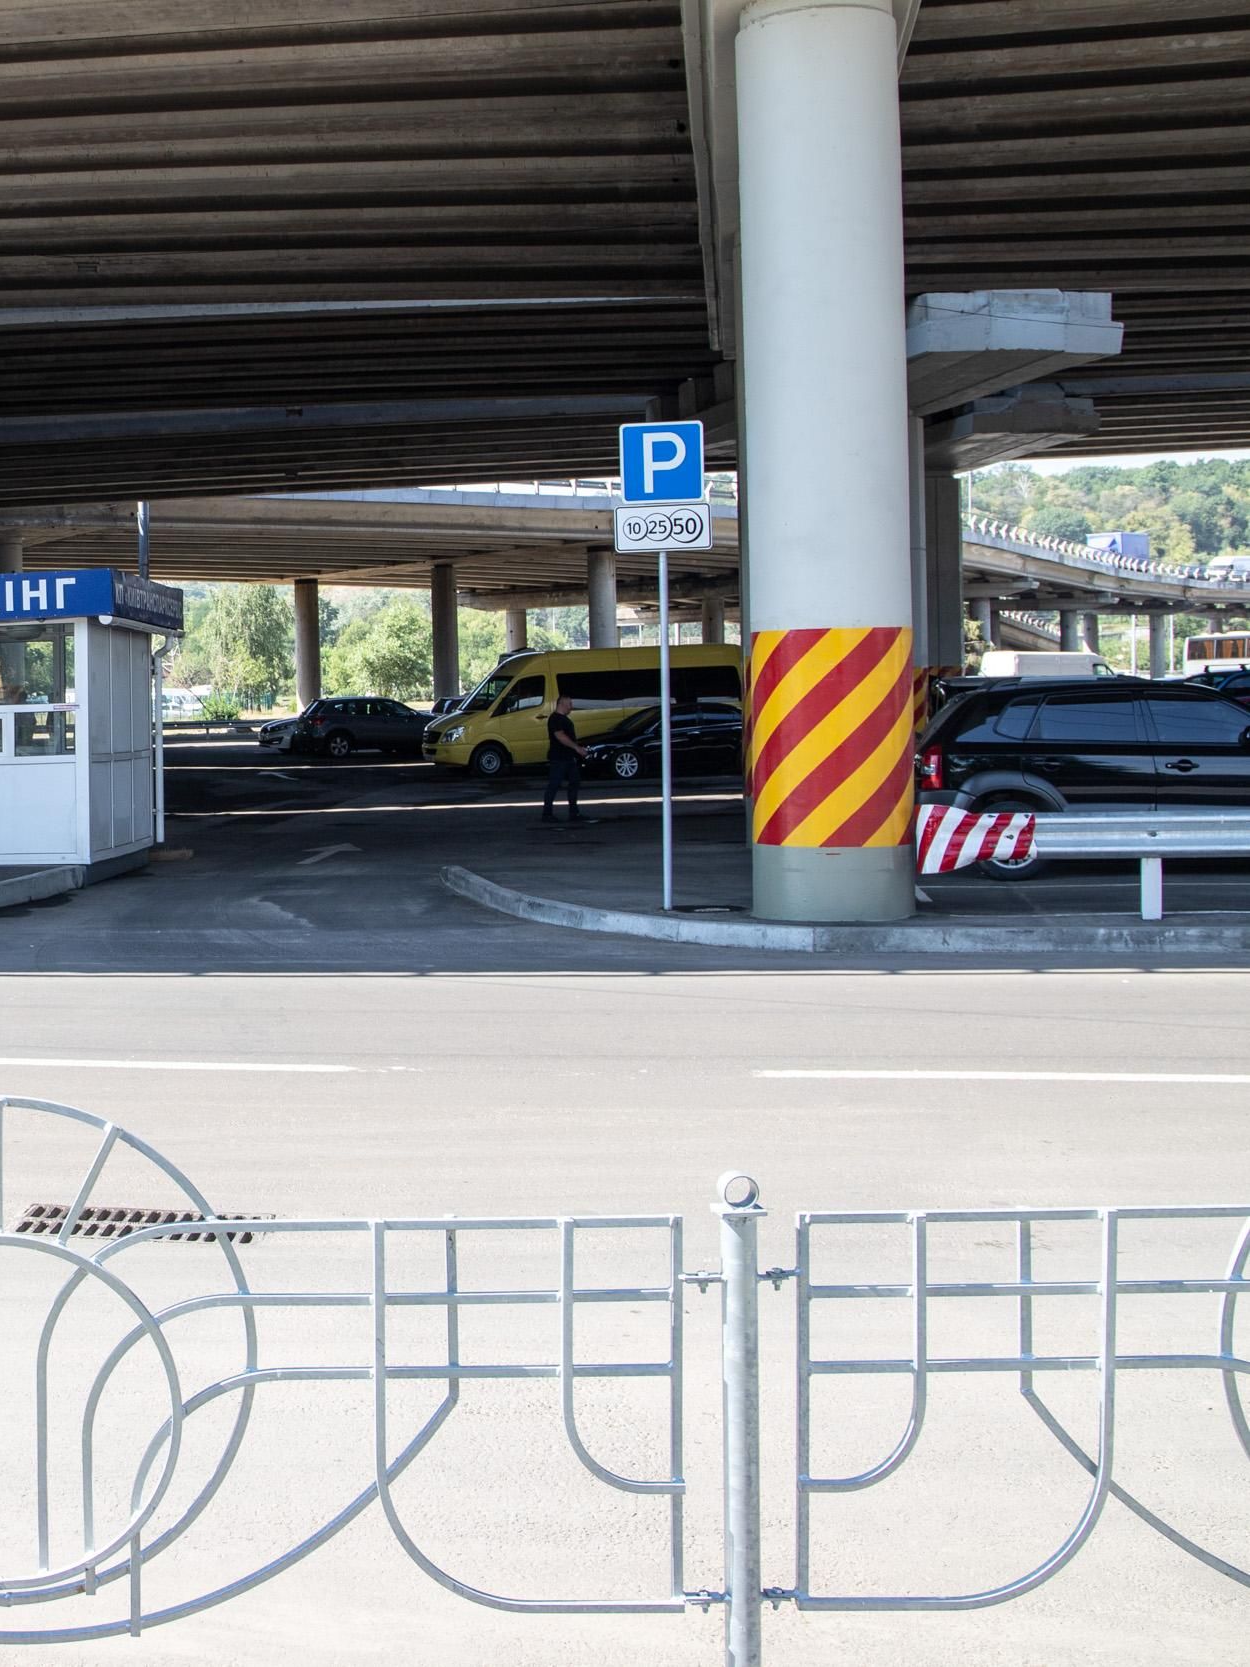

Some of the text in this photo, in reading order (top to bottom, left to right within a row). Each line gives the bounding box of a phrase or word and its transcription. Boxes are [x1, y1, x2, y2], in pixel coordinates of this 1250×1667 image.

[643, 432, 686, 494] P
[627, 517, 697, 535] 10 25 50
